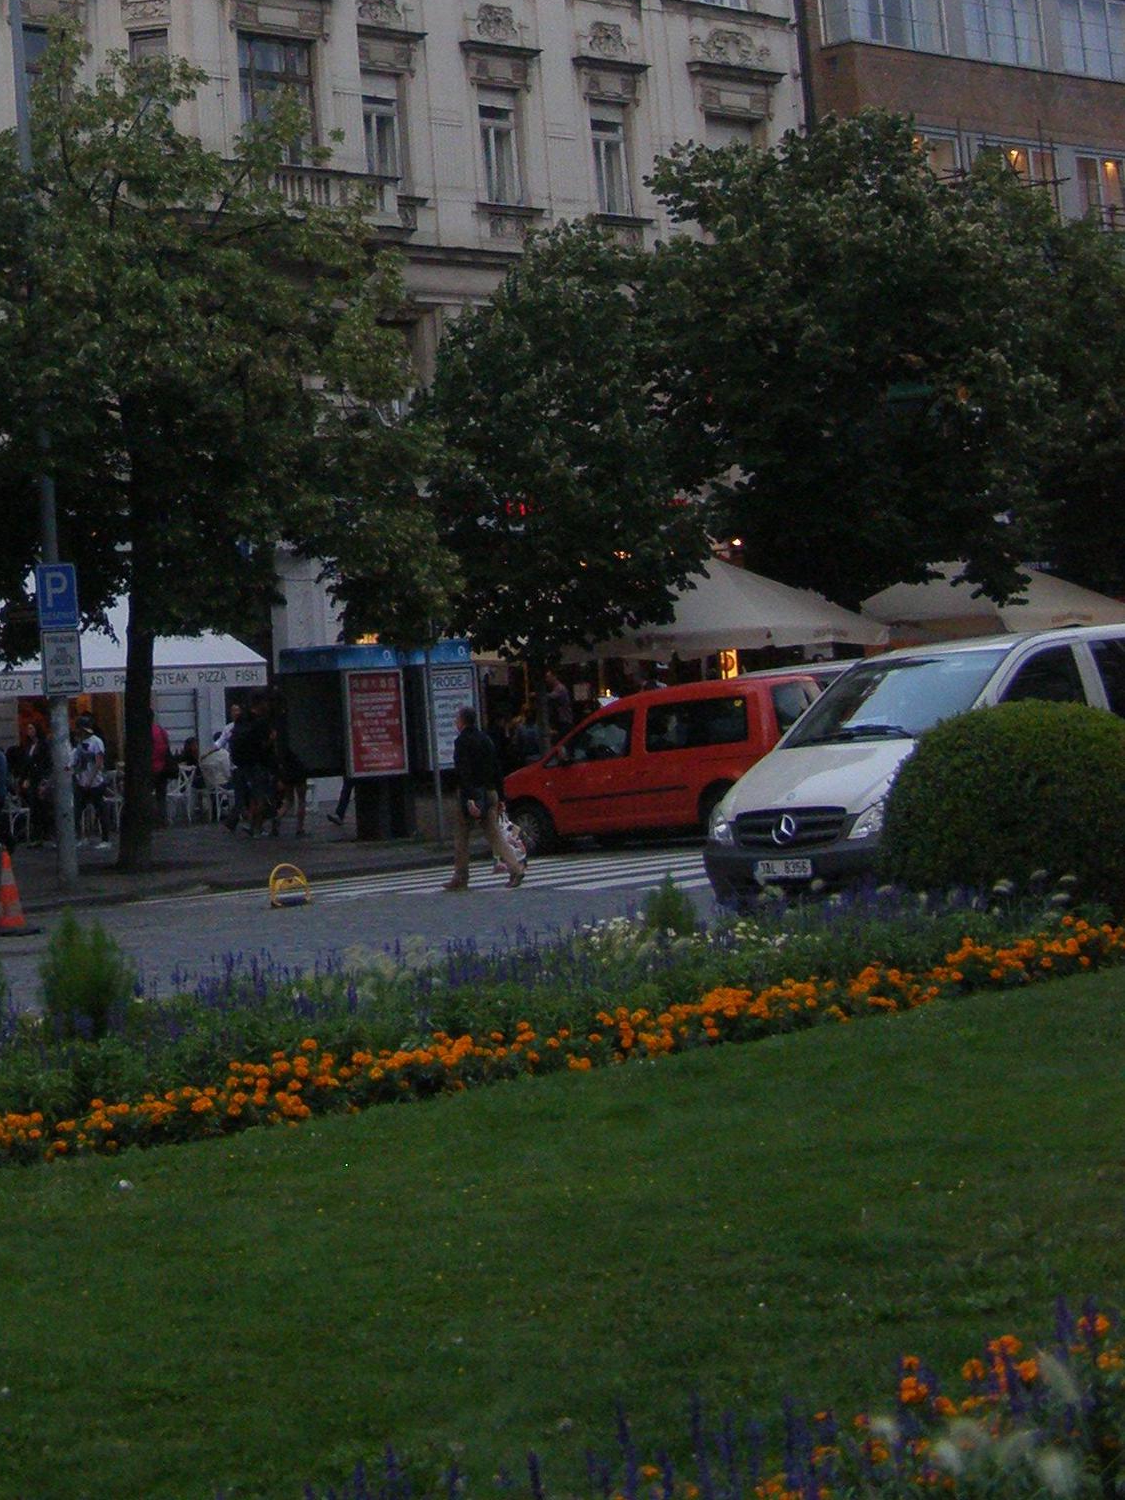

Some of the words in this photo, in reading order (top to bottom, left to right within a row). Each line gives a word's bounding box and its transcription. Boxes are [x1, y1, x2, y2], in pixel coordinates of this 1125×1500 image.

[44, 571, 67, 608] P
[154, 672, 189, 685] STEAK
[198, 670, 227, 682] PIZZA
[236, 669, 258, 681] FISH
